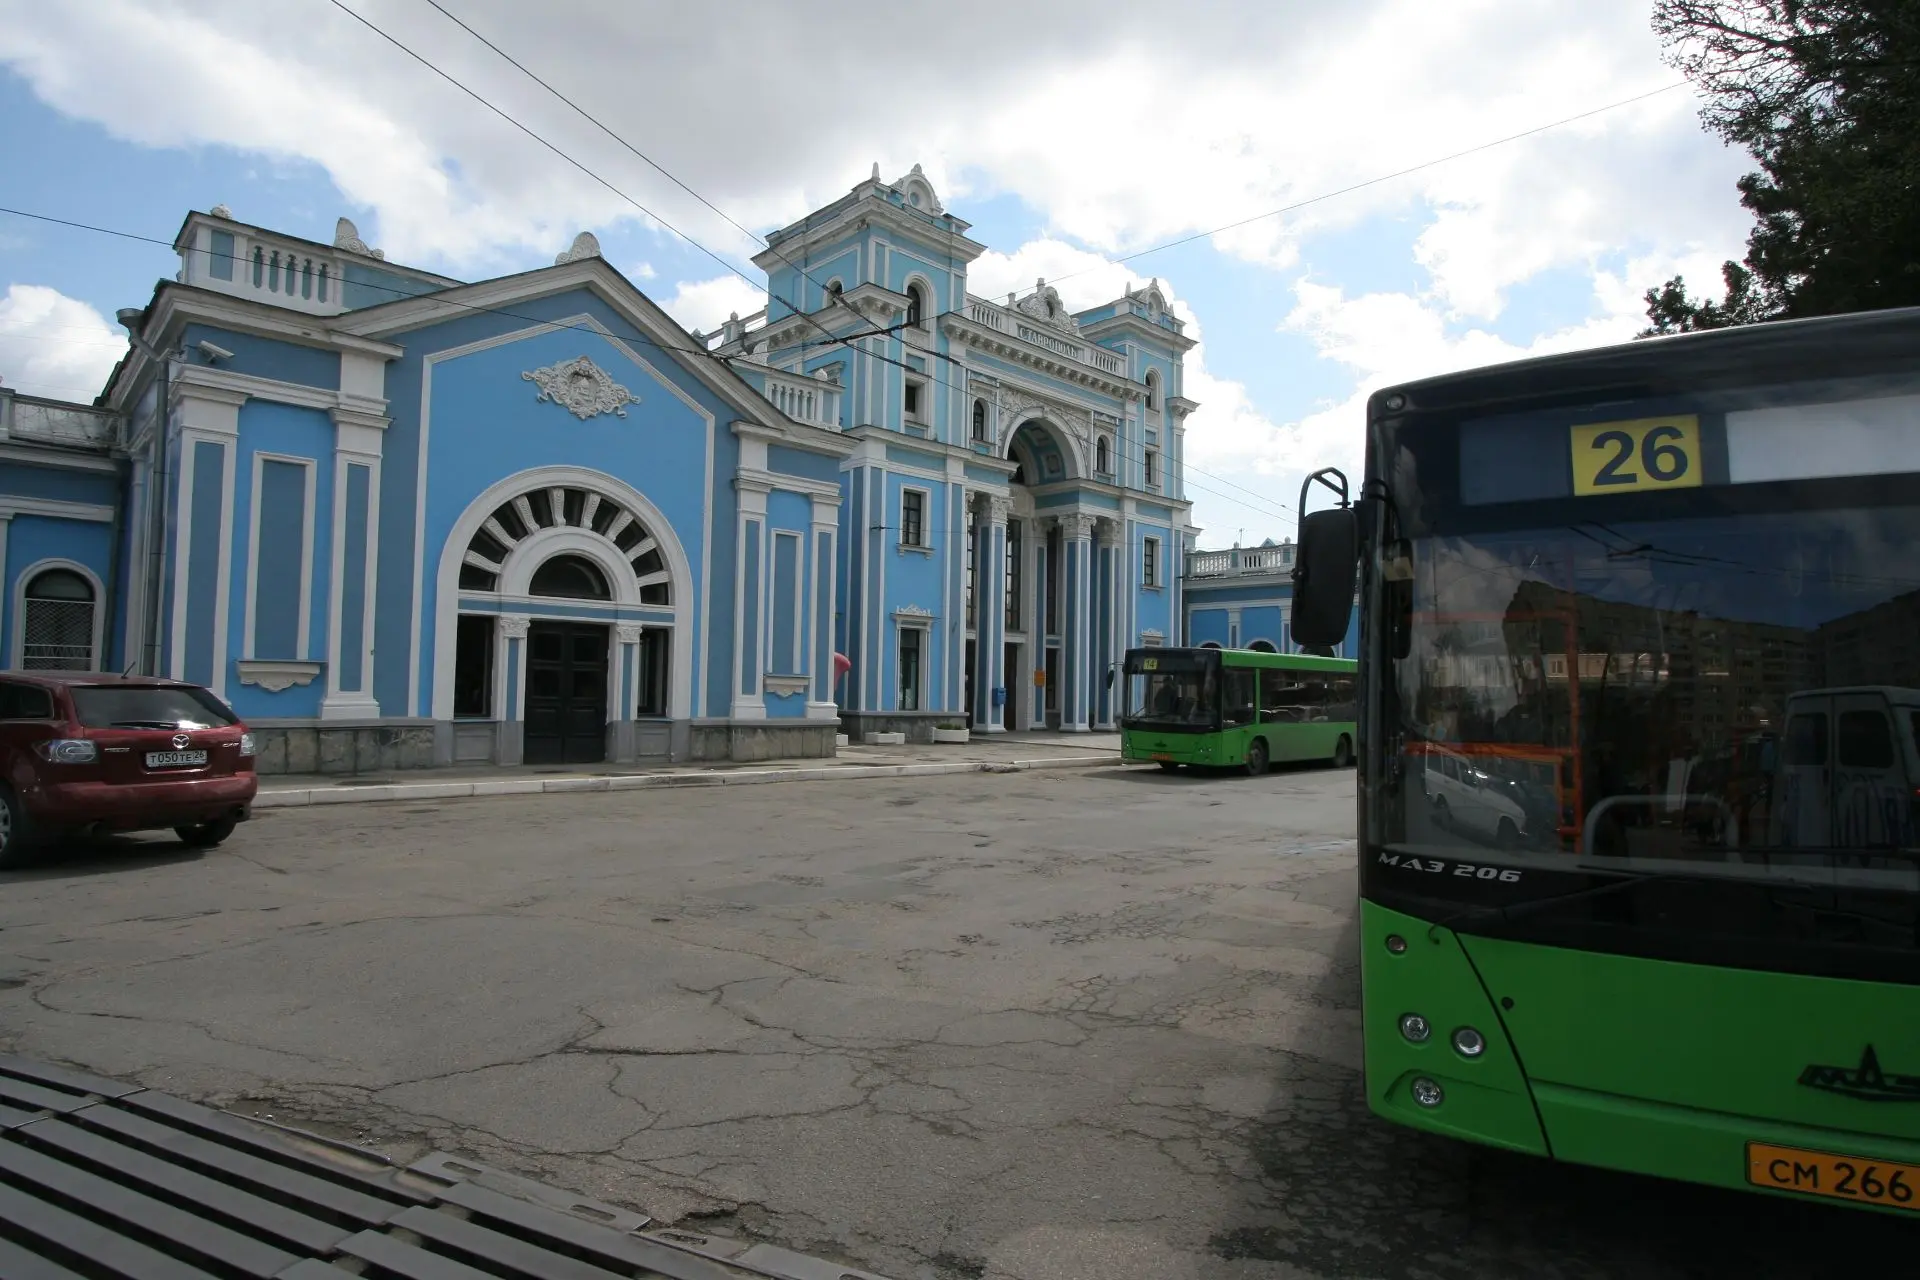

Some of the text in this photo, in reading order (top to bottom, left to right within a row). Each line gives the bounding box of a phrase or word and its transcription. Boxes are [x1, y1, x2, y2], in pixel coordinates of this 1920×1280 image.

[1019, 327, 1077, 358] СТАВРОПОЛЬ
[1591, 425, 1688, 486] 26
[1145, 659, 1156, 669] 14
[1378, 852, 1522, 883] МАЗ 206
[1768, 1159, 1914, 1203] СМ 266
